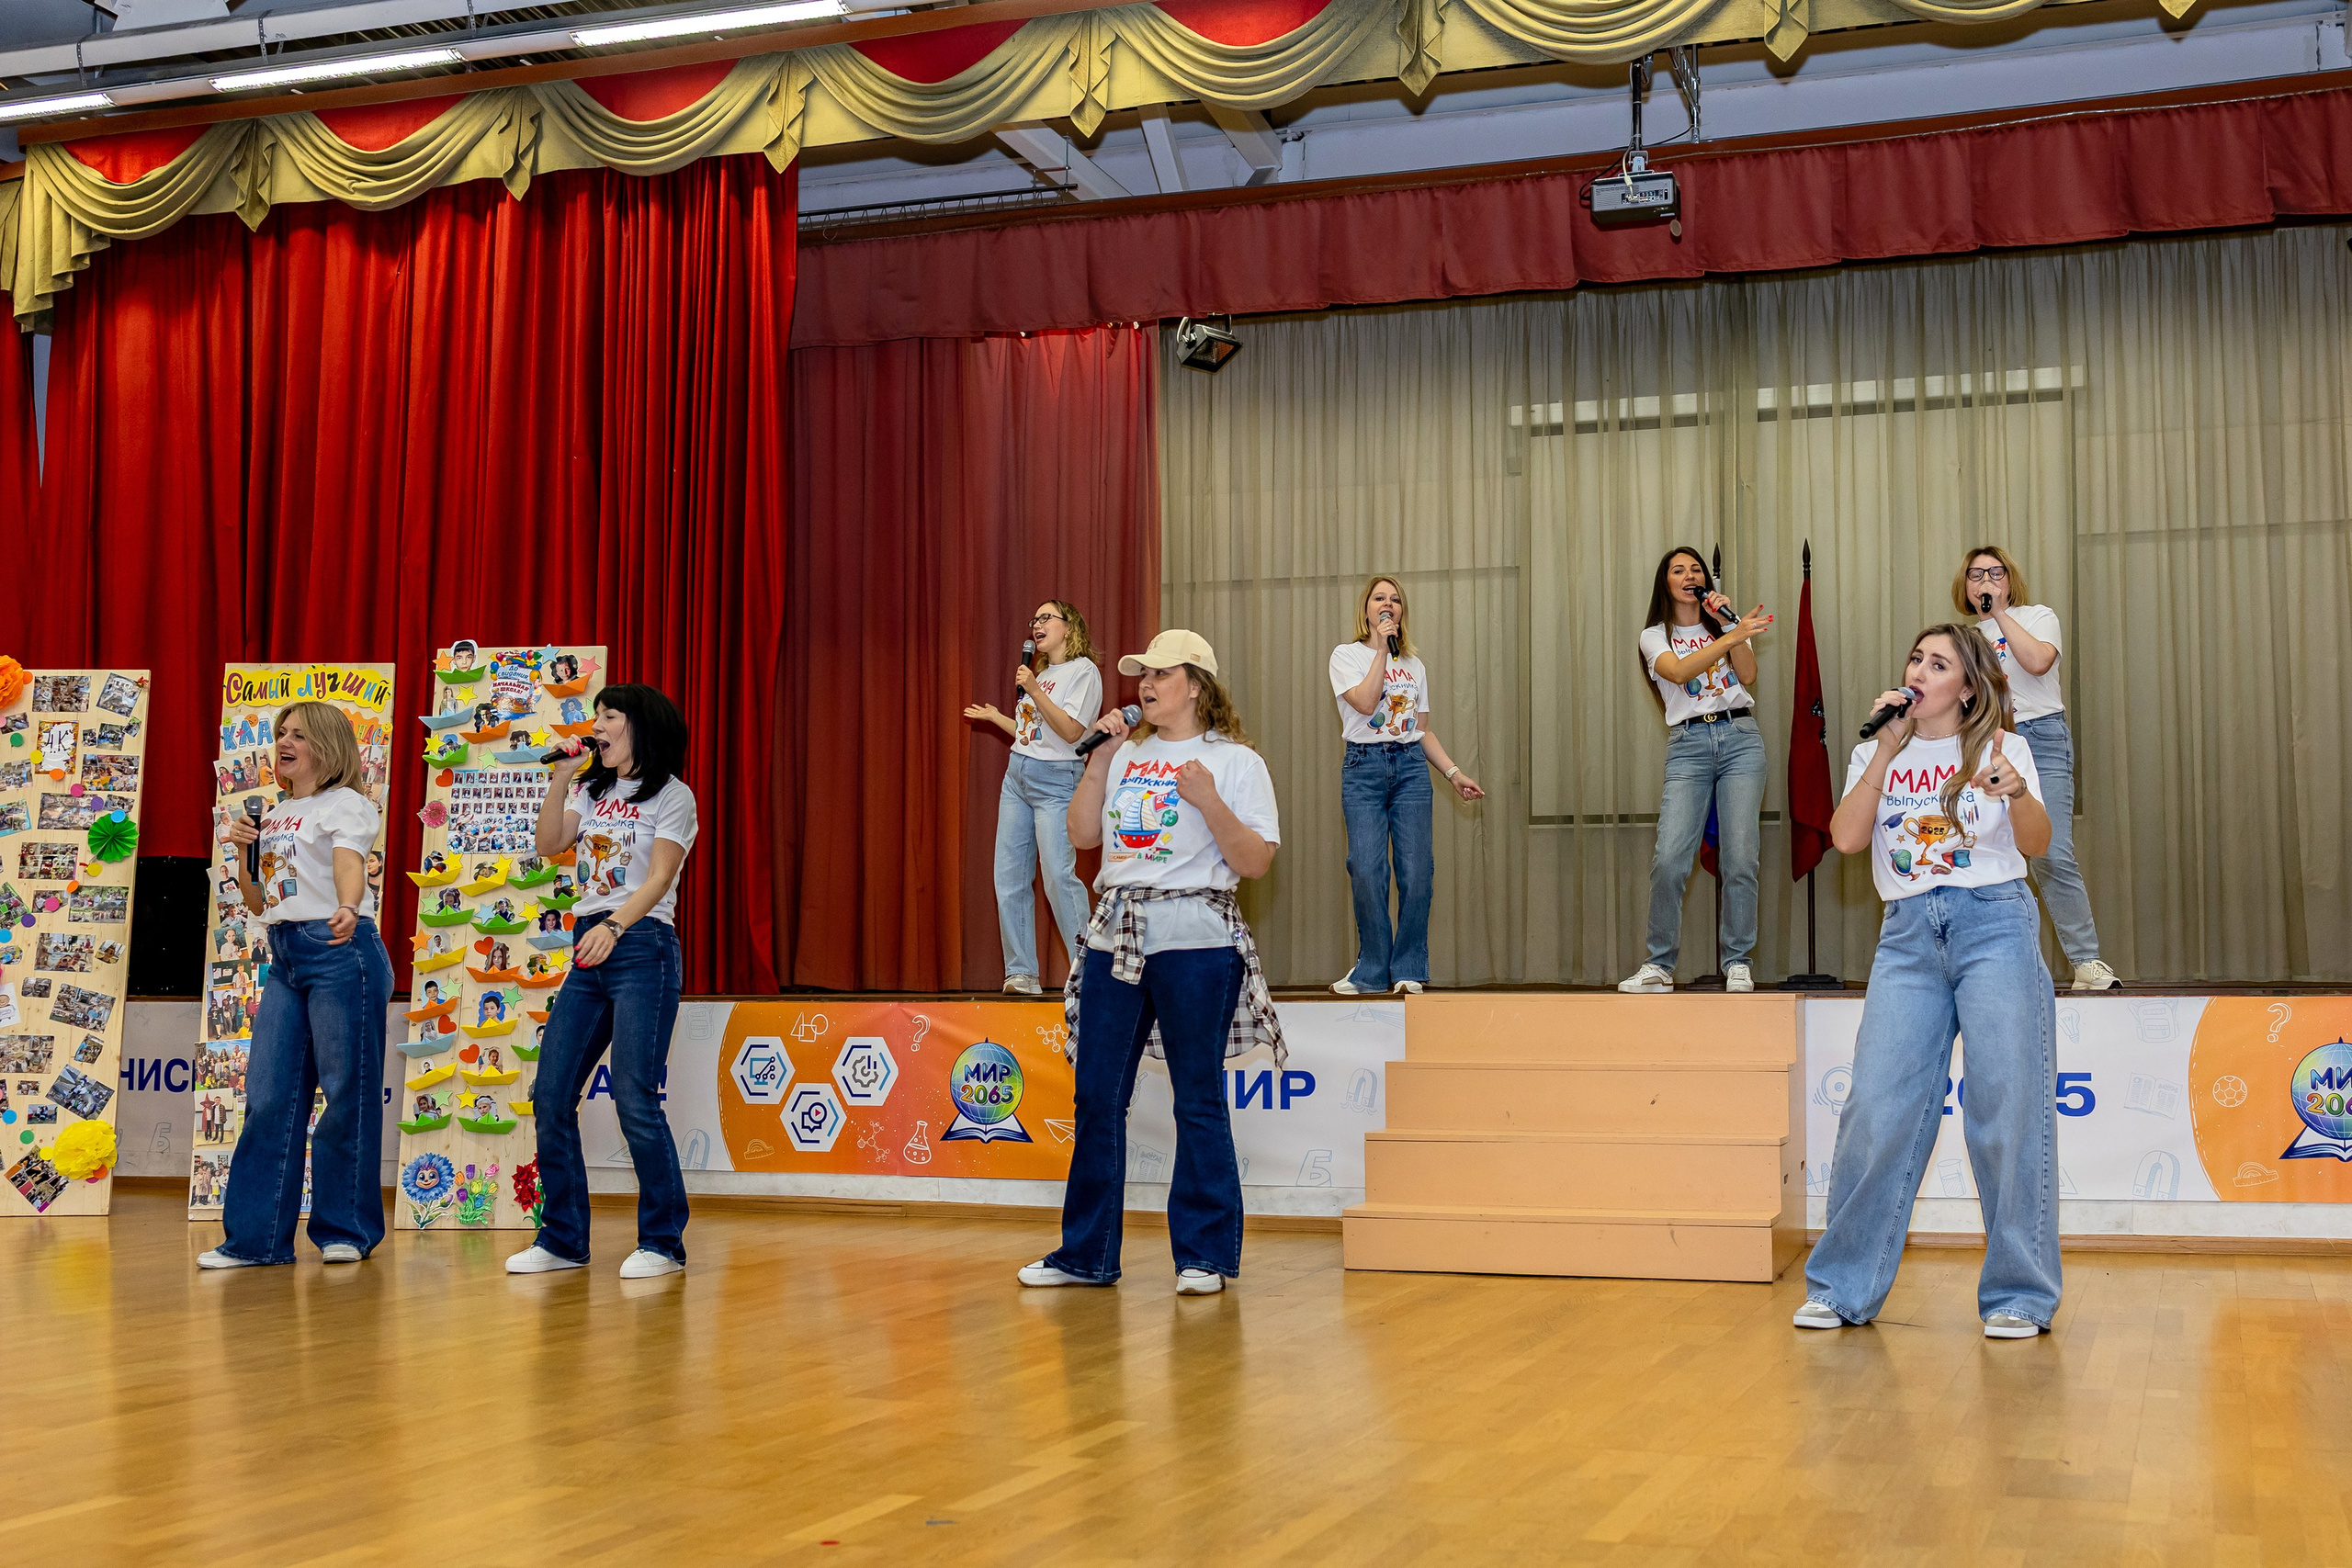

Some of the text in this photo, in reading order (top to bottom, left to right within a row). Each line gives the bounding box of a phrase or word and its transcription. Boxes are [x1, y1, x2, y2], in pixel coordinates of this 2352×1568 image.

[226, 671, 390, 705] Самый лучший
[1920, 826, 1945, 835] 2025
[964, 1062, 1012, 1083] МИР
[960, 1084, 1014, 1105] 2065
[1222, 1069, 1317, 1111] ИР
